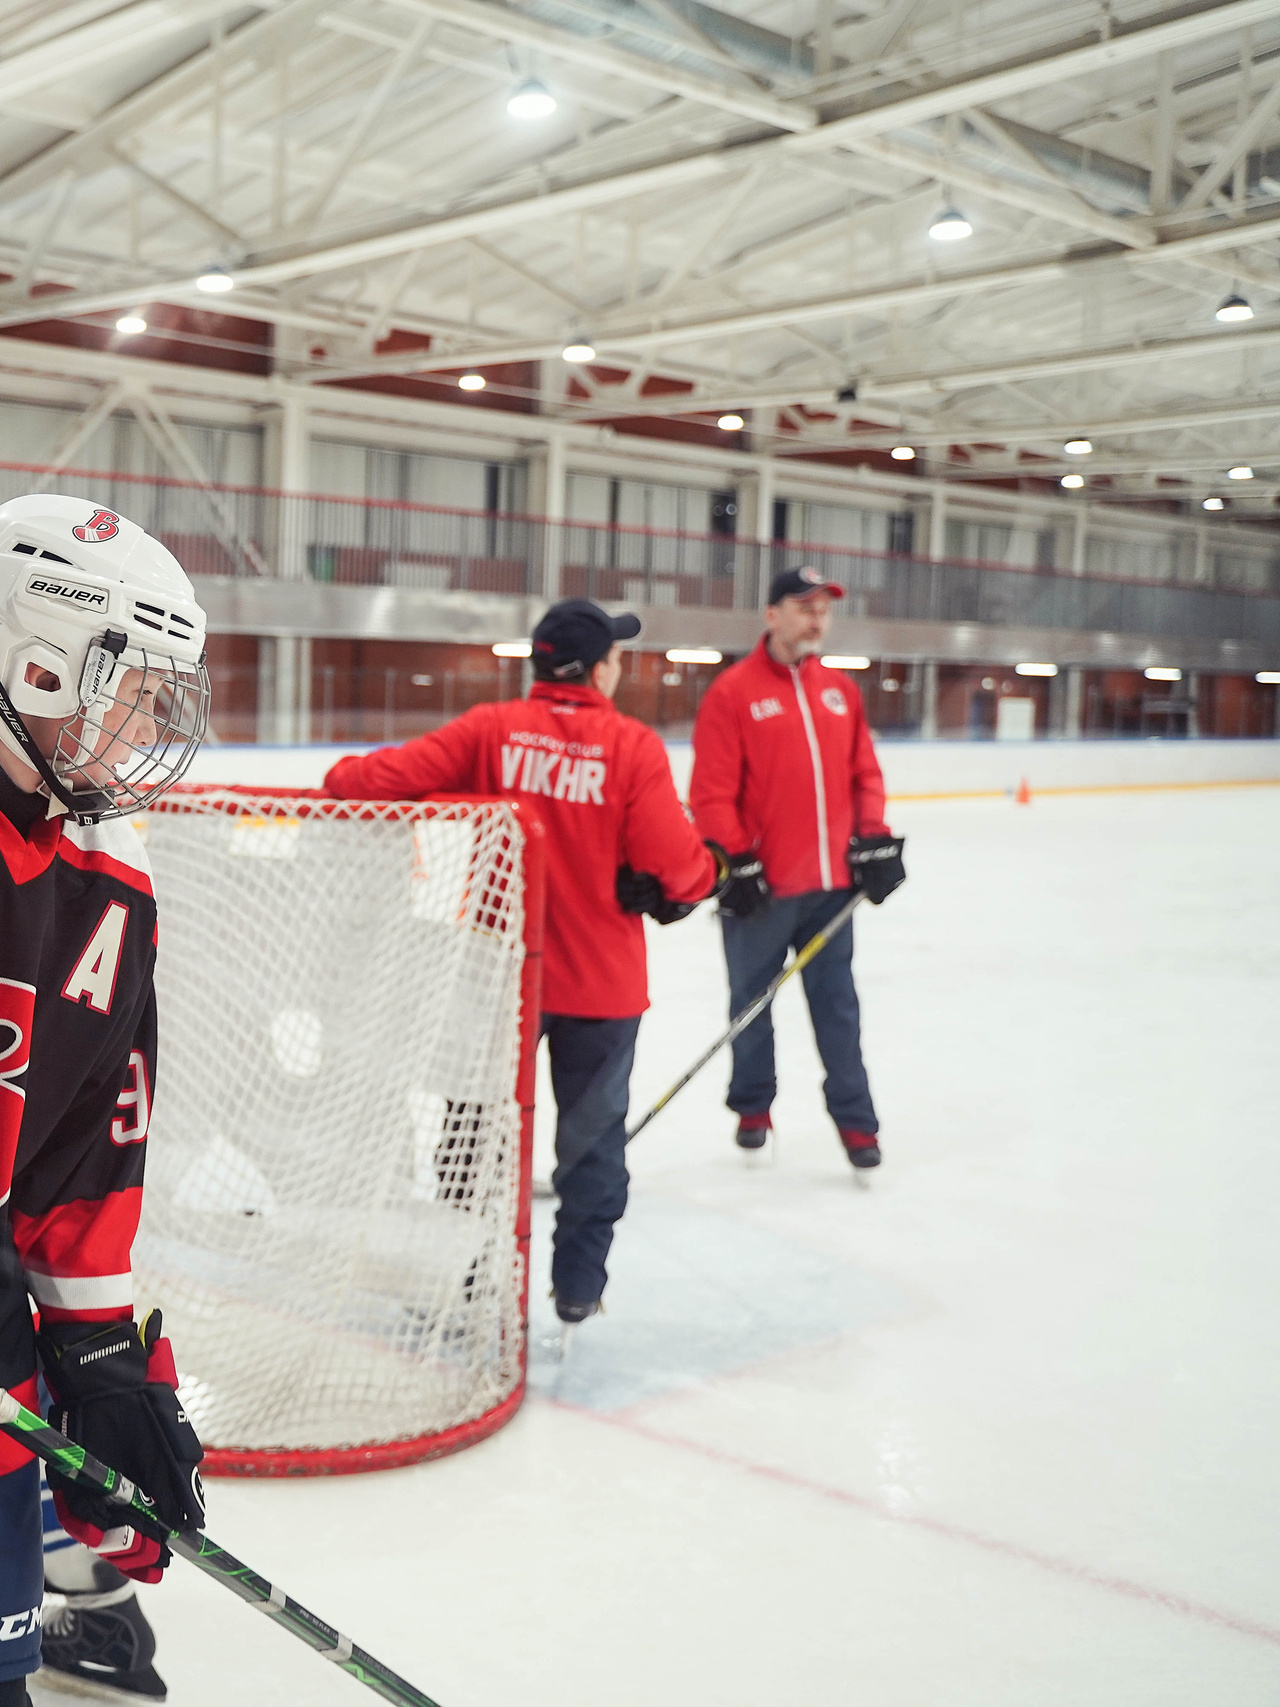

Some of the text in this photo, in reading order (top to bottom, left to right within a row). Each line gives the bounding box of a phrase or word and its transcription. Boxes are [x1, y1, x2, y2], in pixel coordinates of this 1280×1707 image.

[509, 731, 604, 759] HOCKEY CLUB
[501, 744, 606, 806] VIKHR
[60, 898, 130, 1016] A
[79, 1339, 131, 1366] WARRIOR
